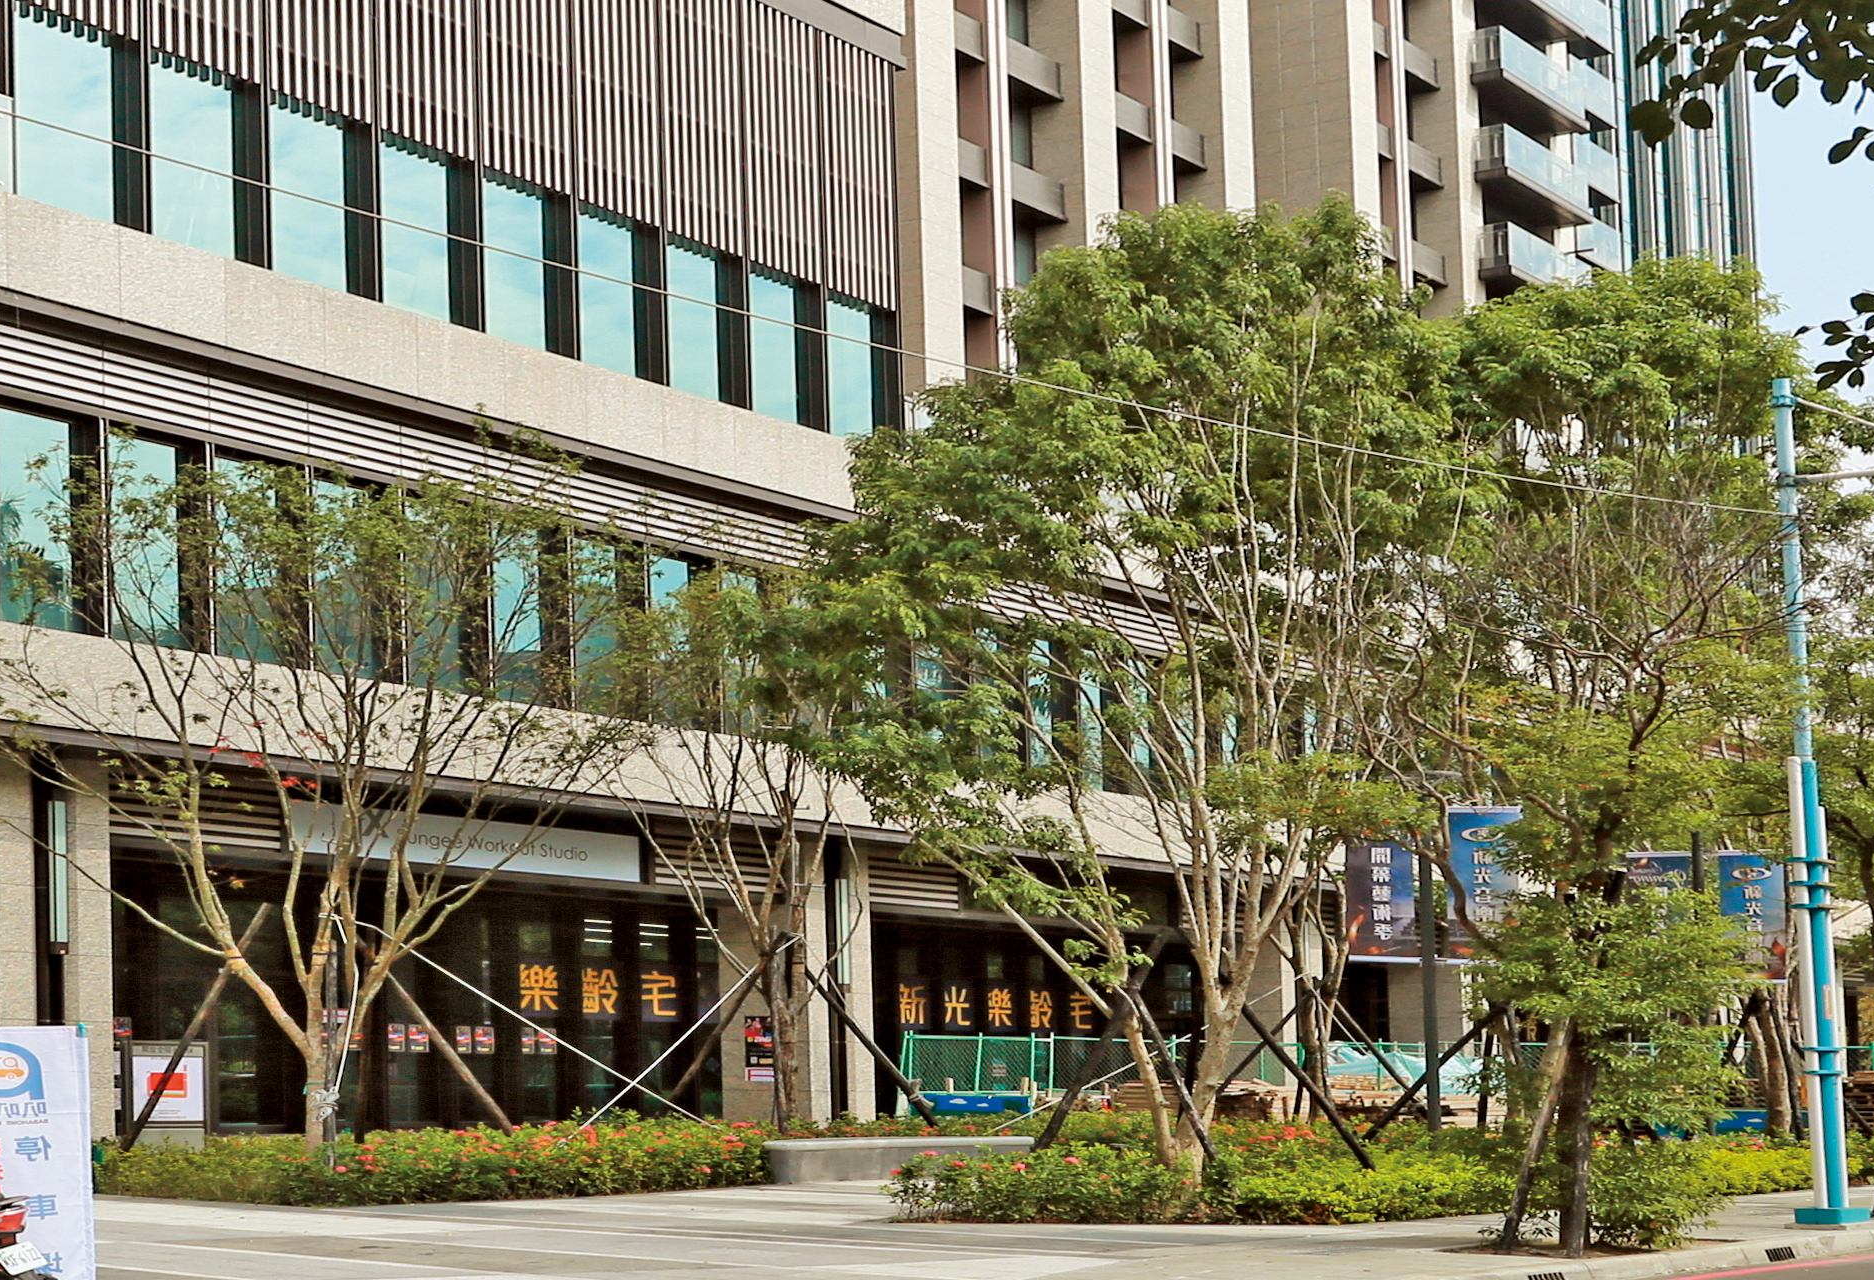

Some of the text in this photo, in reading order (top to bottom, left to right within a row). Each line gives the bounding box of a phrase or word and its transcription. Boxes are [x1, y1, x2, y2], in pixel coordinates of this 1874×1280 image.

[399, 830, 463, 850] ungee
[539, 838, 588, 862] Studio
[519, 963, 677, 1017] 樂齡宅
[899, 983, 1093, 1029] 新光樂齡宅
